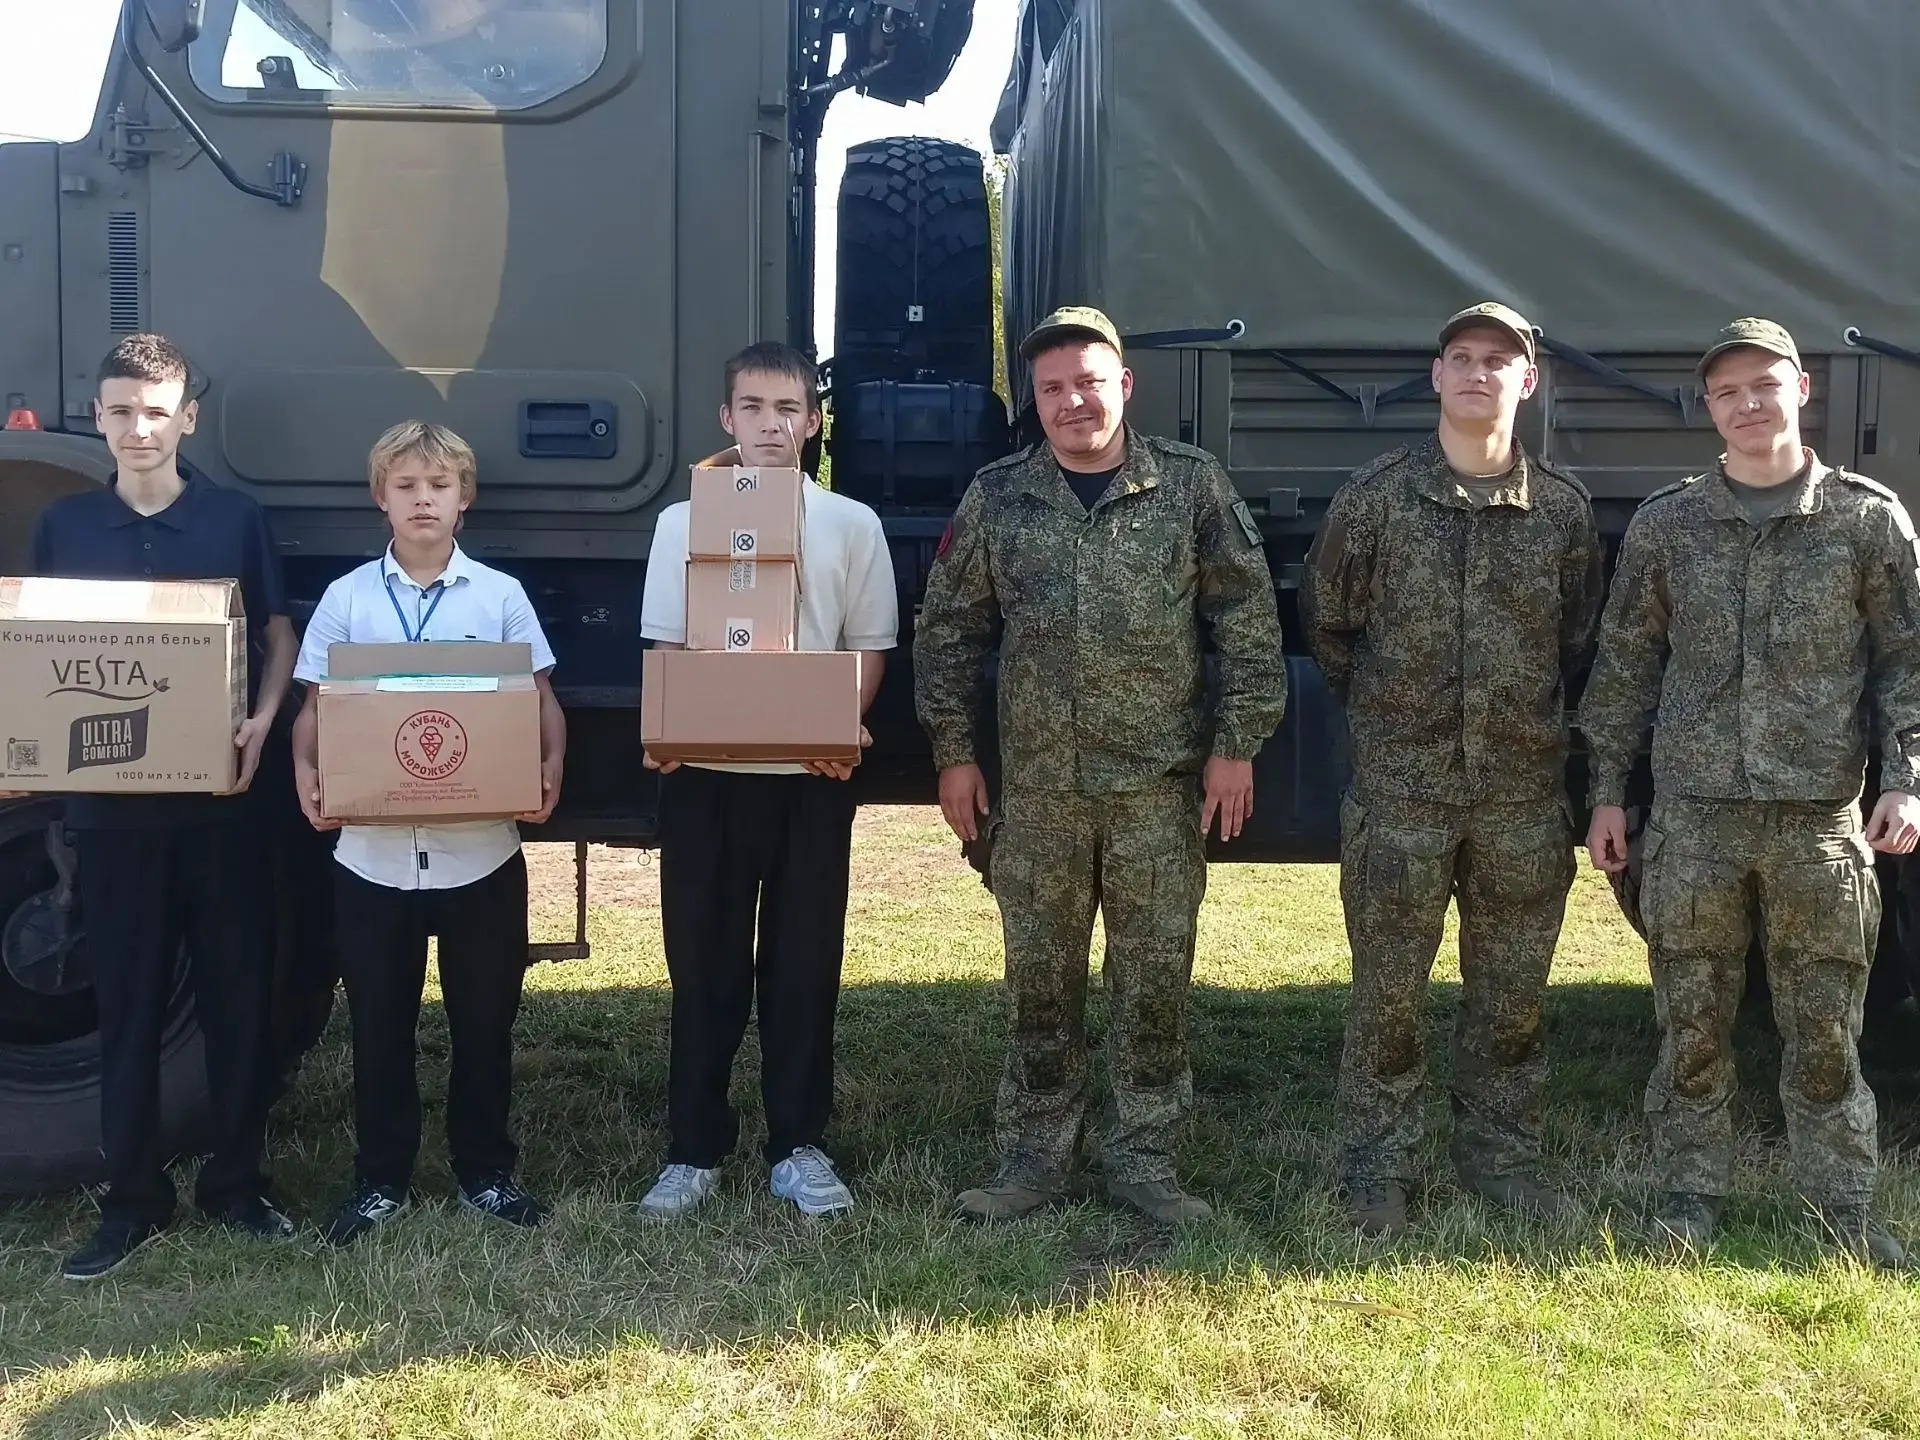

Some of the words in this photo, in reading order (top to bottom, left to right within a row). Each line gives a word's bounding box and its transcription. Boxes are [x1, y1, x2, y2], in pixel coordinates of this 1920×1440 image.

[2, 631, 119, 645] Кондиционер
[124, 634, 155, 645] для
[161, 633, 211, 645] белья
[51, 654, 148, 690] VESTA
[409, 714, 451, 730] КУБАНЬ
[82, 718, 132, 746] ULTRA
[82, 743, 132, 761] COMFORT
[401, 749, 462, 777] МОРОЖЕНОЕ
[116, 771, 143, 780] 1000
[147, 772, 162, 780] мл
[177, 771, 189, 780] 12
